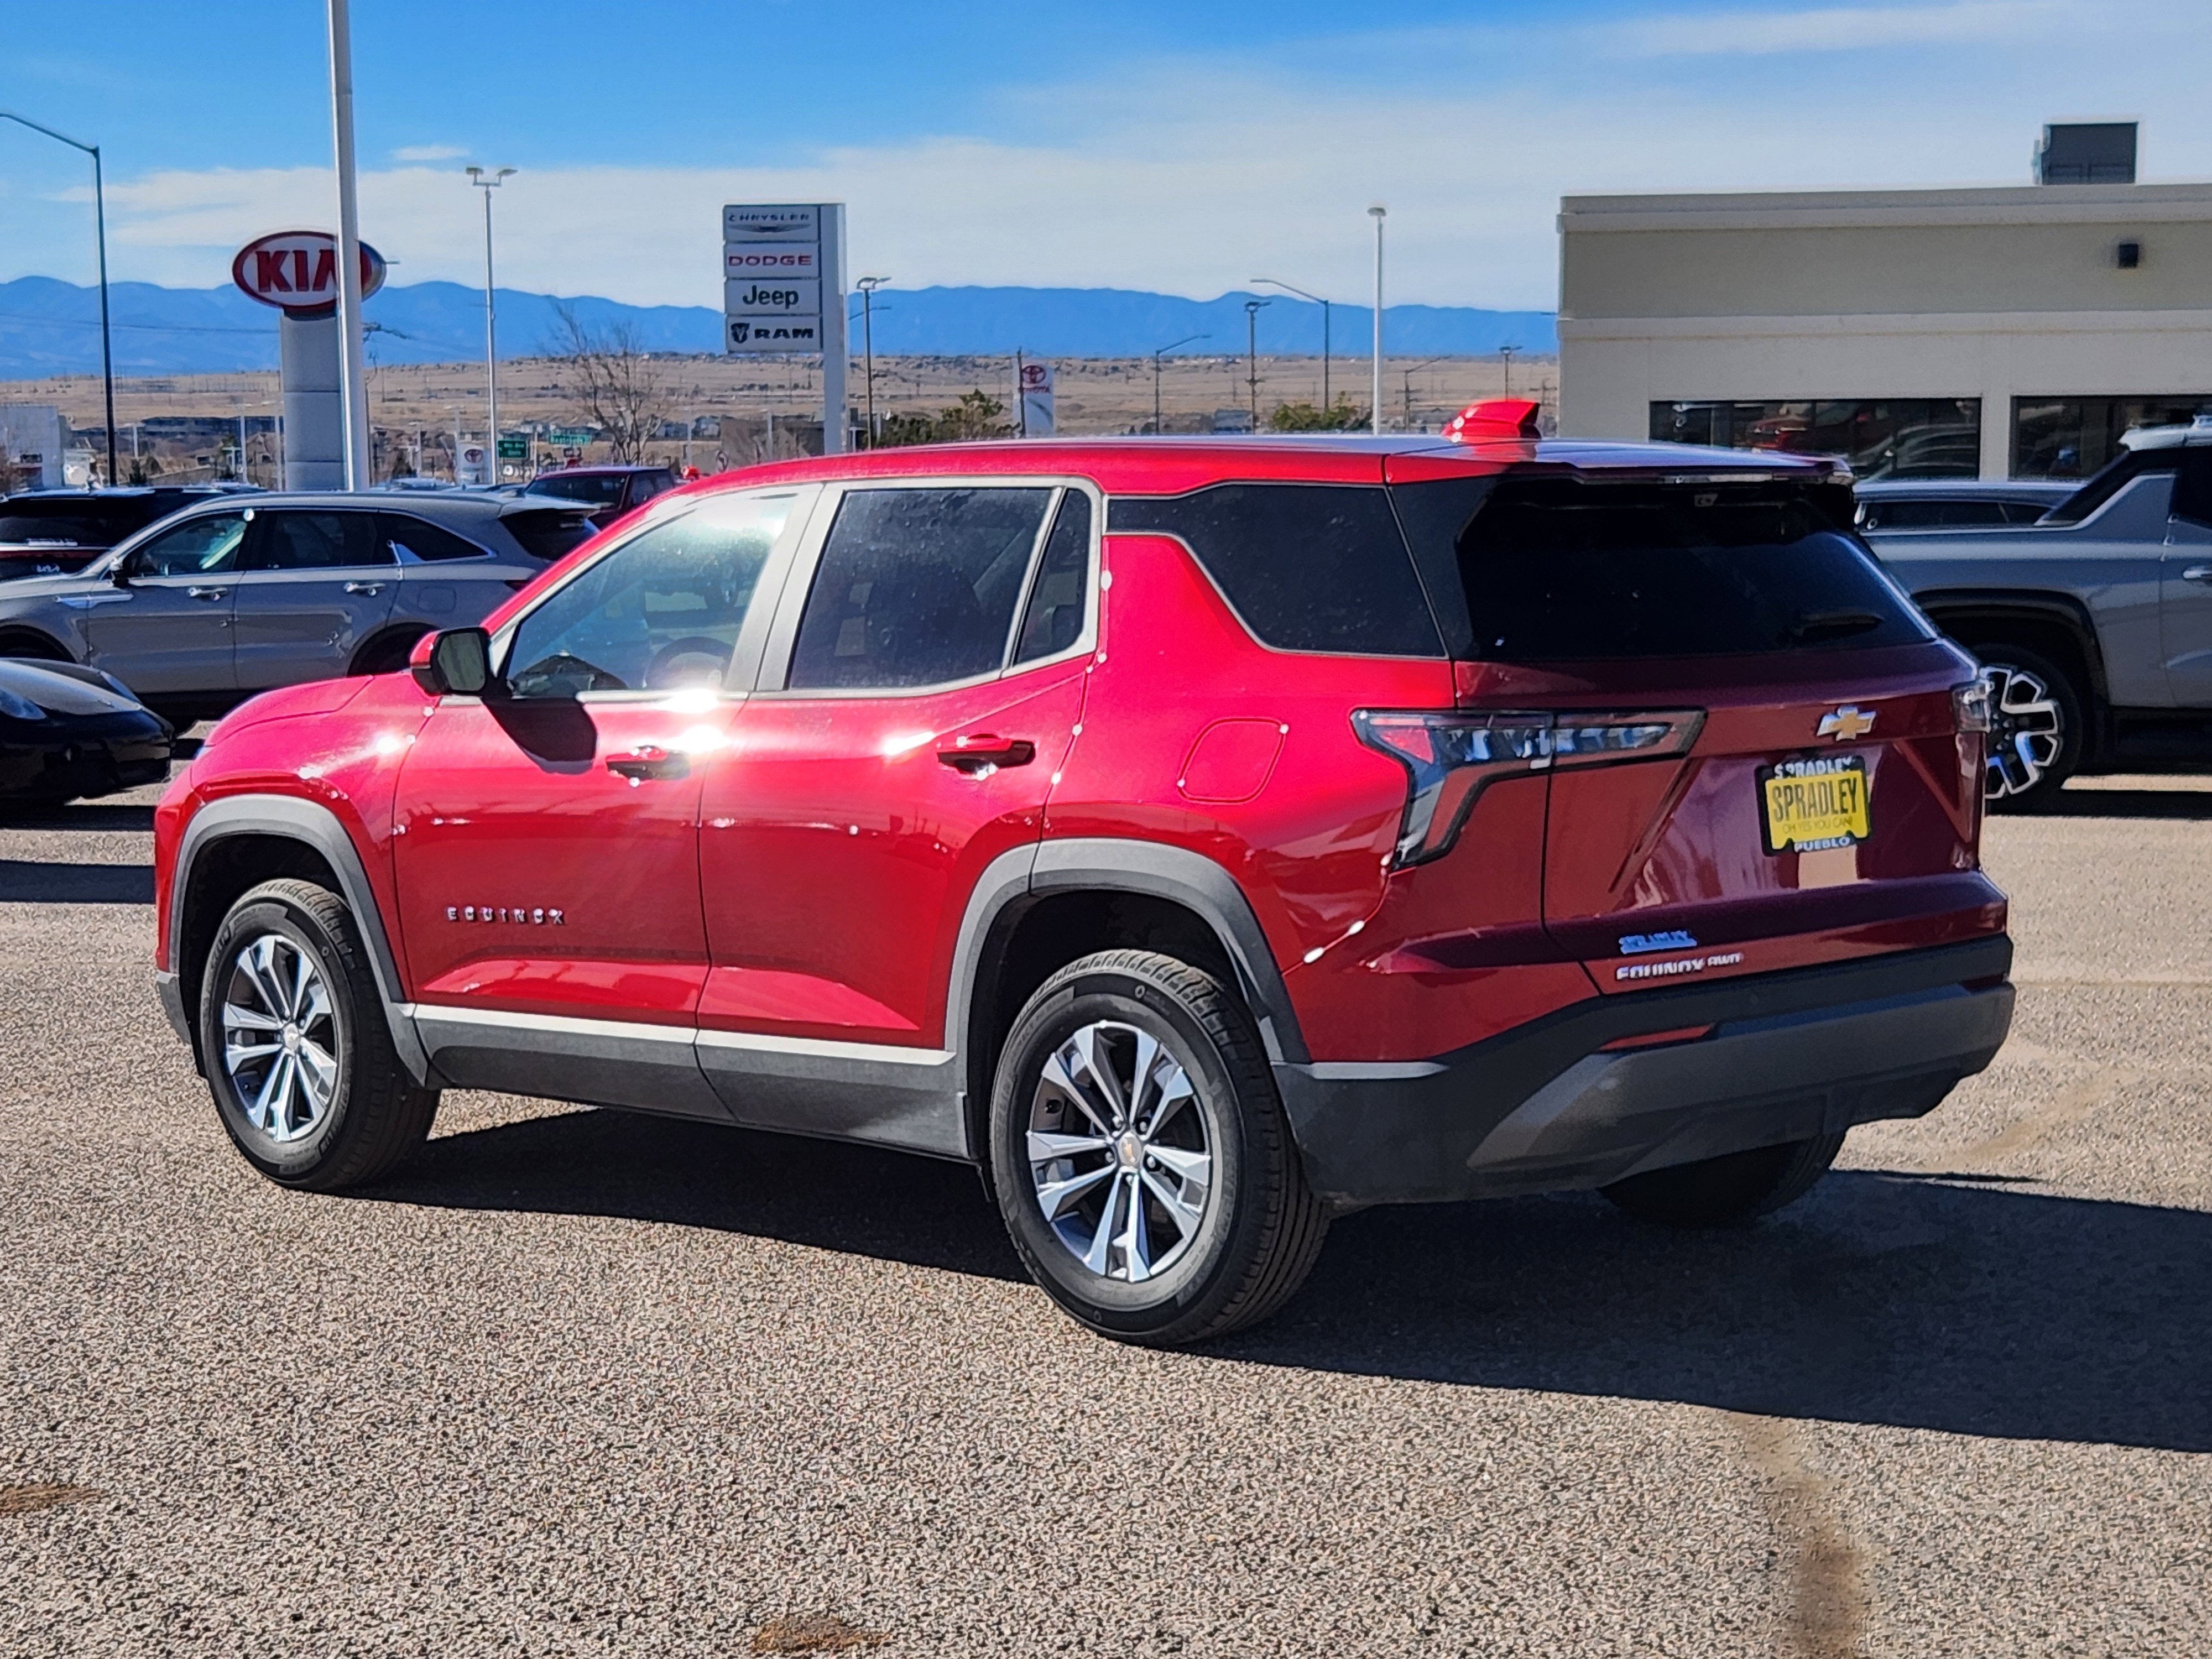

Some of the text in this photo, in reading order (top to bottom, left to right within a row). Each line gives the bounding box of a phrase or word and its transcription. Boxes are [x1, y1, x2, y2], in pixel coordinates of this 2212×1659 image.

[728, 255, 812, 267] DODGE
[742, 285, 799, 310] Jeep
[754, 328, 813, 339] RAM
[1774, 755, 1853, 780] SPRADLEY
[1772, 777, 1857, 823] SPRADLEY
[1794, 836, 1850, 853] PUEBLO
[445, 906, 563, 925] EQUINOX
